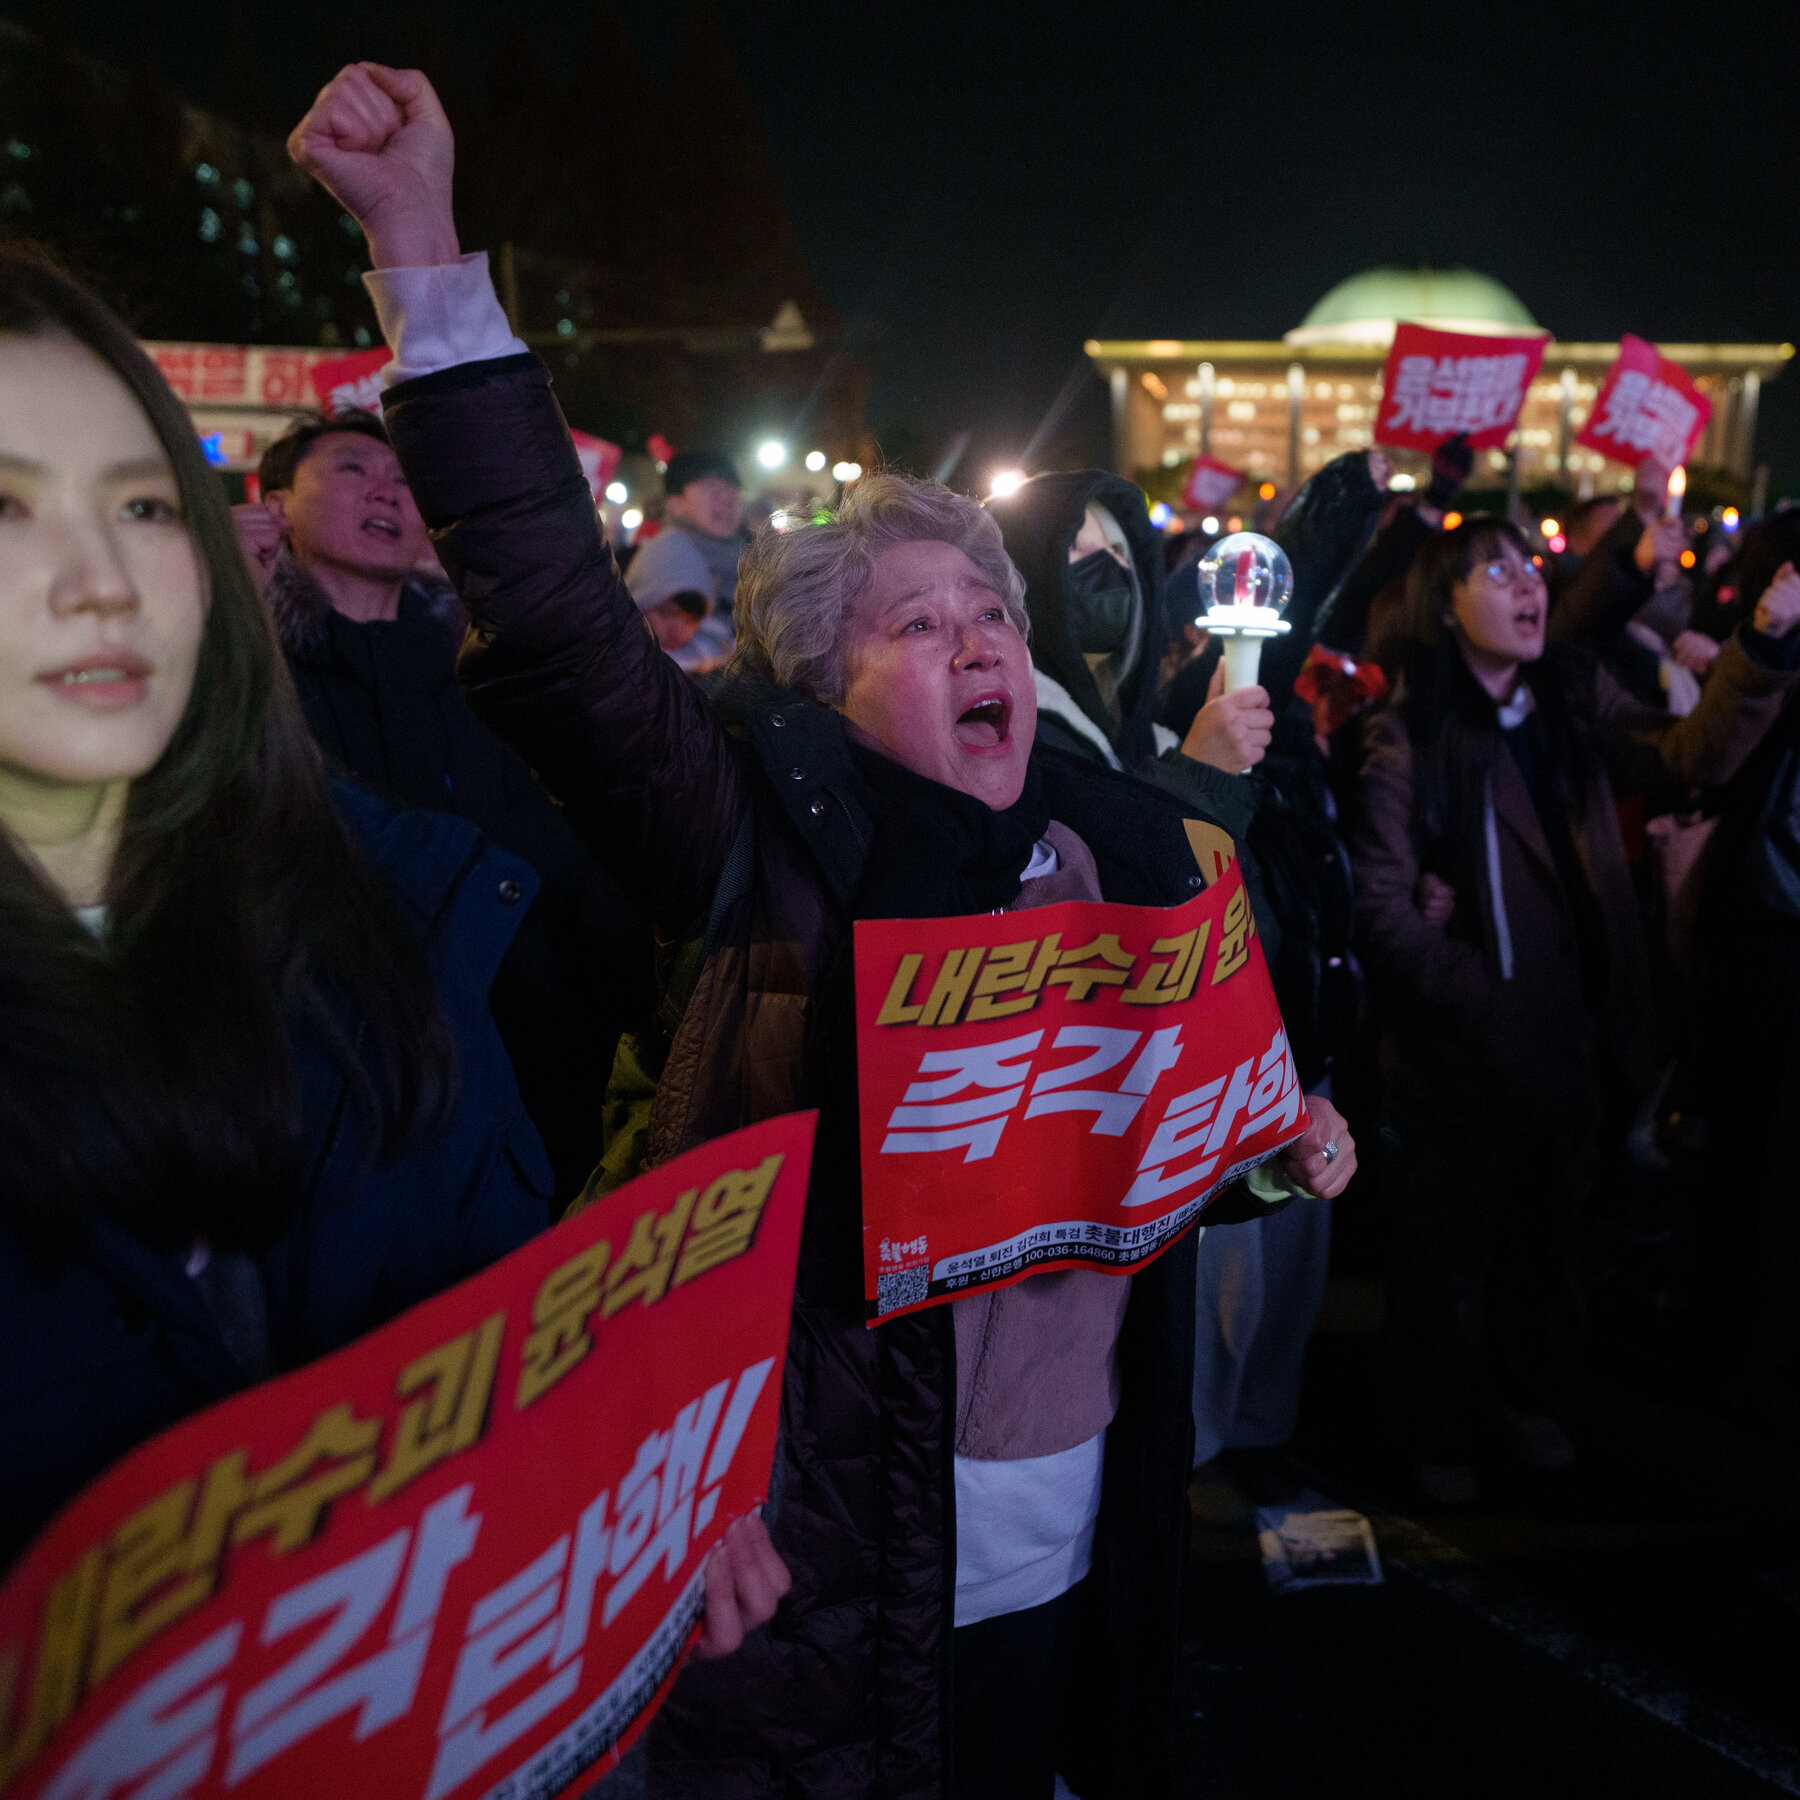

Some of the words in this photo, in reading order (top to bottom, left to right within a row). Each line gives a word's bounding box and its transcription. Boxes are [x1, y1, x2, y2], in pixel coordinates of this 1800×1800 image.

[876, 919, 1211, 1026] 내란수괴
[1211, 884, 1257, 985] 윤
[880, 1024, 1184, 1163] 즉각
[1120, 1024, 1307, 1207] 탄핵
[516, 1152, 786, 1410] 윤석열
[879, 1235, 928, 1263] 촛불행동
[945, 1275, 969, 1289] 후원
[980, 1258, 1023, 1281] 신한은행
[1025, 1245, 1115, 1264] 100-036-164860
[1118, 1241, 1157, 1262] 촛불행동
[947, 1255, 985, 1274] 윤석열
[990, 1245, 1013, 1263] 퇴진
[1017, 1230, 1051, 1251] 김건희
[1055, 1228, 1080, 1241] 특검
[1084, 1216, 1171, 1246] 촛불대행진
[425, 1357, 776, 1800] 탄핵!
